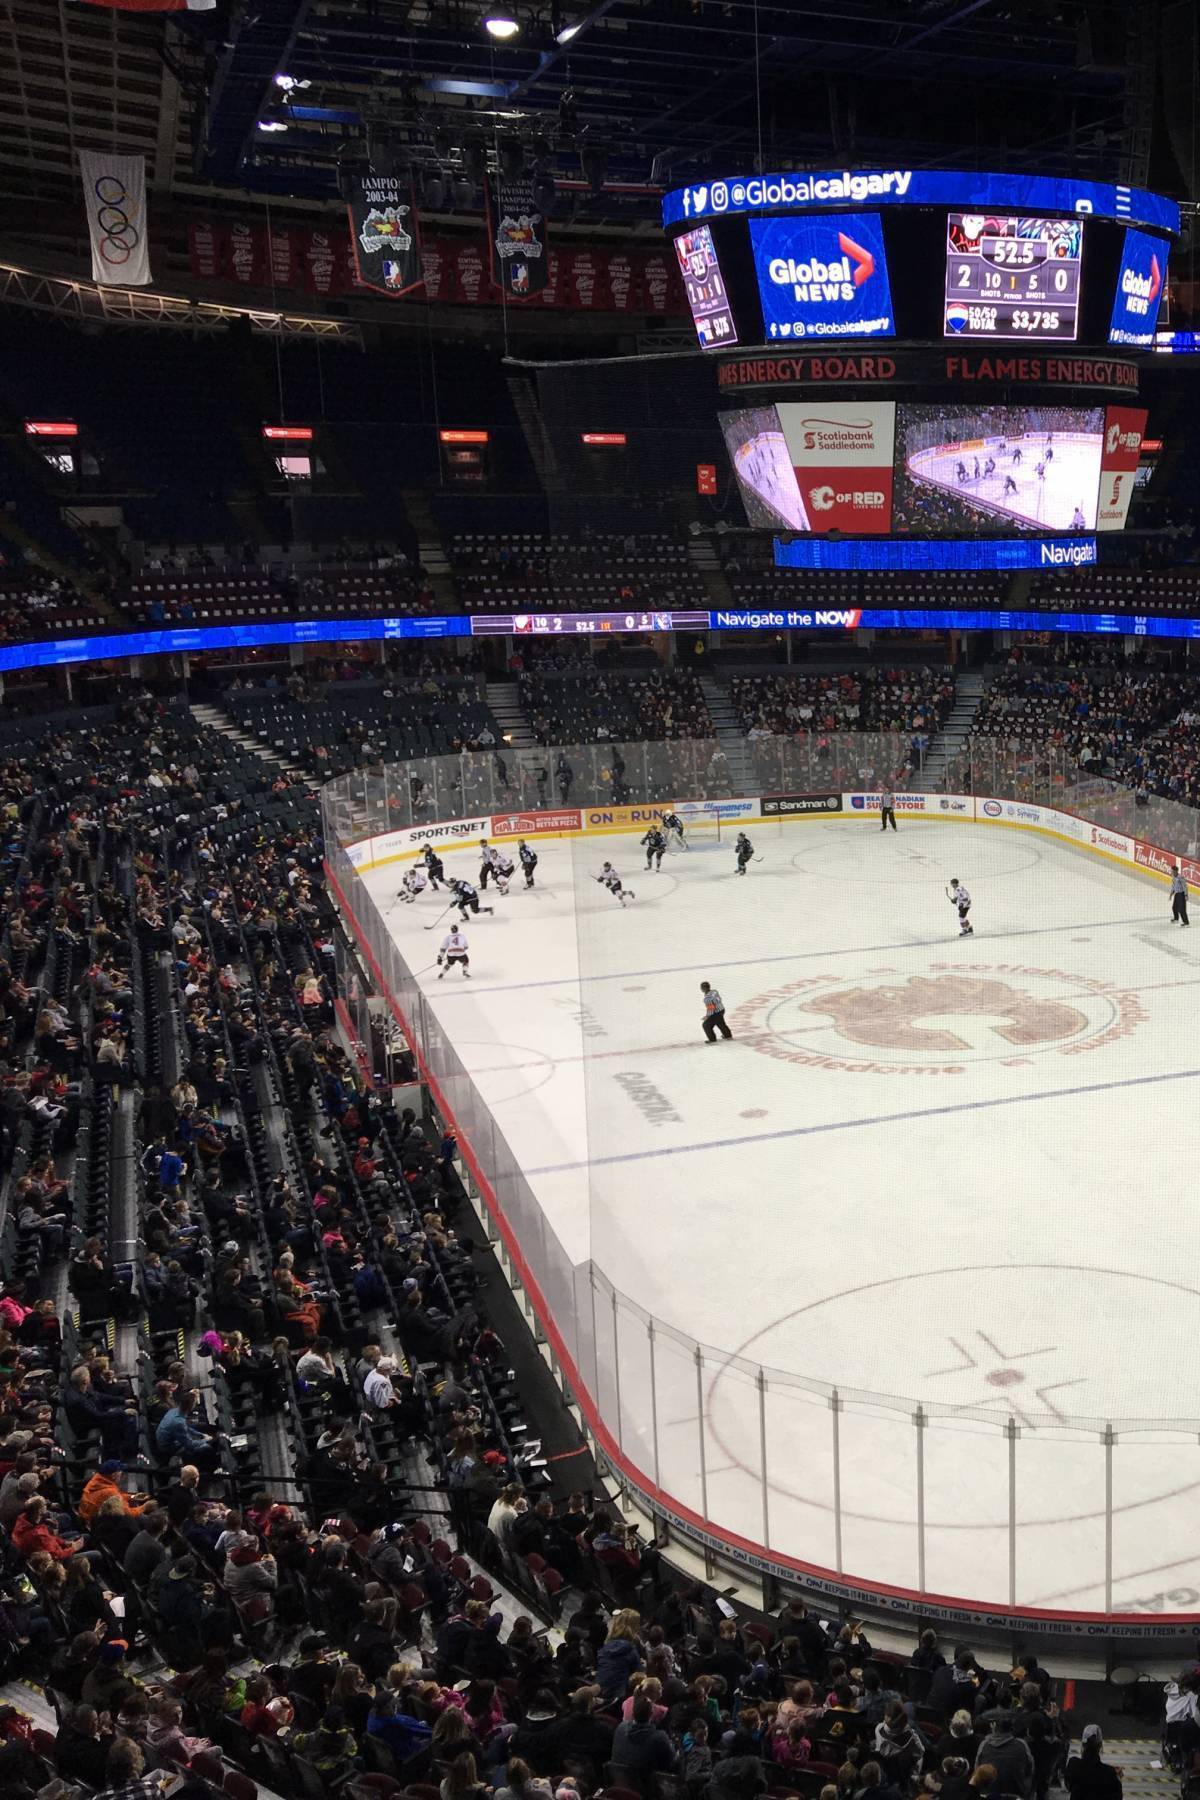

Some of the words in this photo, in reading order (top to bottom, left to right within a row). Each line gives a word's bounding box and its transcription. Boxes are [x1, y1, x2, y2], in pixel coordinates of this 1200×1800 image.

[366, 191, 398, 202] 2003-04
[732, 171, 912, 206] @Globalcalgary
[994, 242, 1033, 264] 52.5
[769, 257, 851, 284] Global
[958, 265, 971, 287] 2
[985, 273, 1001, 288] 10
[1010, 276, 1016, 289] 1
[1029, 275, 1038, 289] 5
[1055, 269, 1067, 291] 0
[1122, 269, 1153, 299] Global
[794, 284, 855, 302] NEWS
[968, 307, 997, 318] 50/50
[1126, 297, 1150, 315] NEWS
[969, 317, 996, 330] TOTAL
[1012, 311, 1059, 331] $3,735
[740, 359, 802, 382] ENERGY
[810, 357, 896, 379] BOARD
[946, 357, 1041, 380] FLAMES
[1046, 359, 1113, 384] ENERGY
[818, 431, 873, 442] Scotiabank
[818, 441, 875, 450] Saddledome
[836, 494, 852, 504] OF
[853, 492, 885, 505] RED
[1099, 510, 1124, 520] Scotiabank
[1041, 543, 1094, 566] Navigate
[535, 618, 547, 627] 10
[554, 618, 562, 631] 2
[576, 621, 595, 631] 52.5
[625, 616, 633, 629] 0
[641, 615, 648, 624] 5
[718, 612, 784, 628] Navigate
[788, 612, 812, 625] the
[816, 611, 855, 625] NOW
[780, 800, 826, 810] Sandman
[589, 812, 613, 825] ON
[631, 809, 664, 822] RUN
[1017, 808, 1040, 822] Synergy
[409, 821, 487, 842] SPORTSNET
[1098, 833, 1128, 853] Scotiabank
[1135, 846, 1148, 863] Tim
[453, 937, 459, 946] 4
